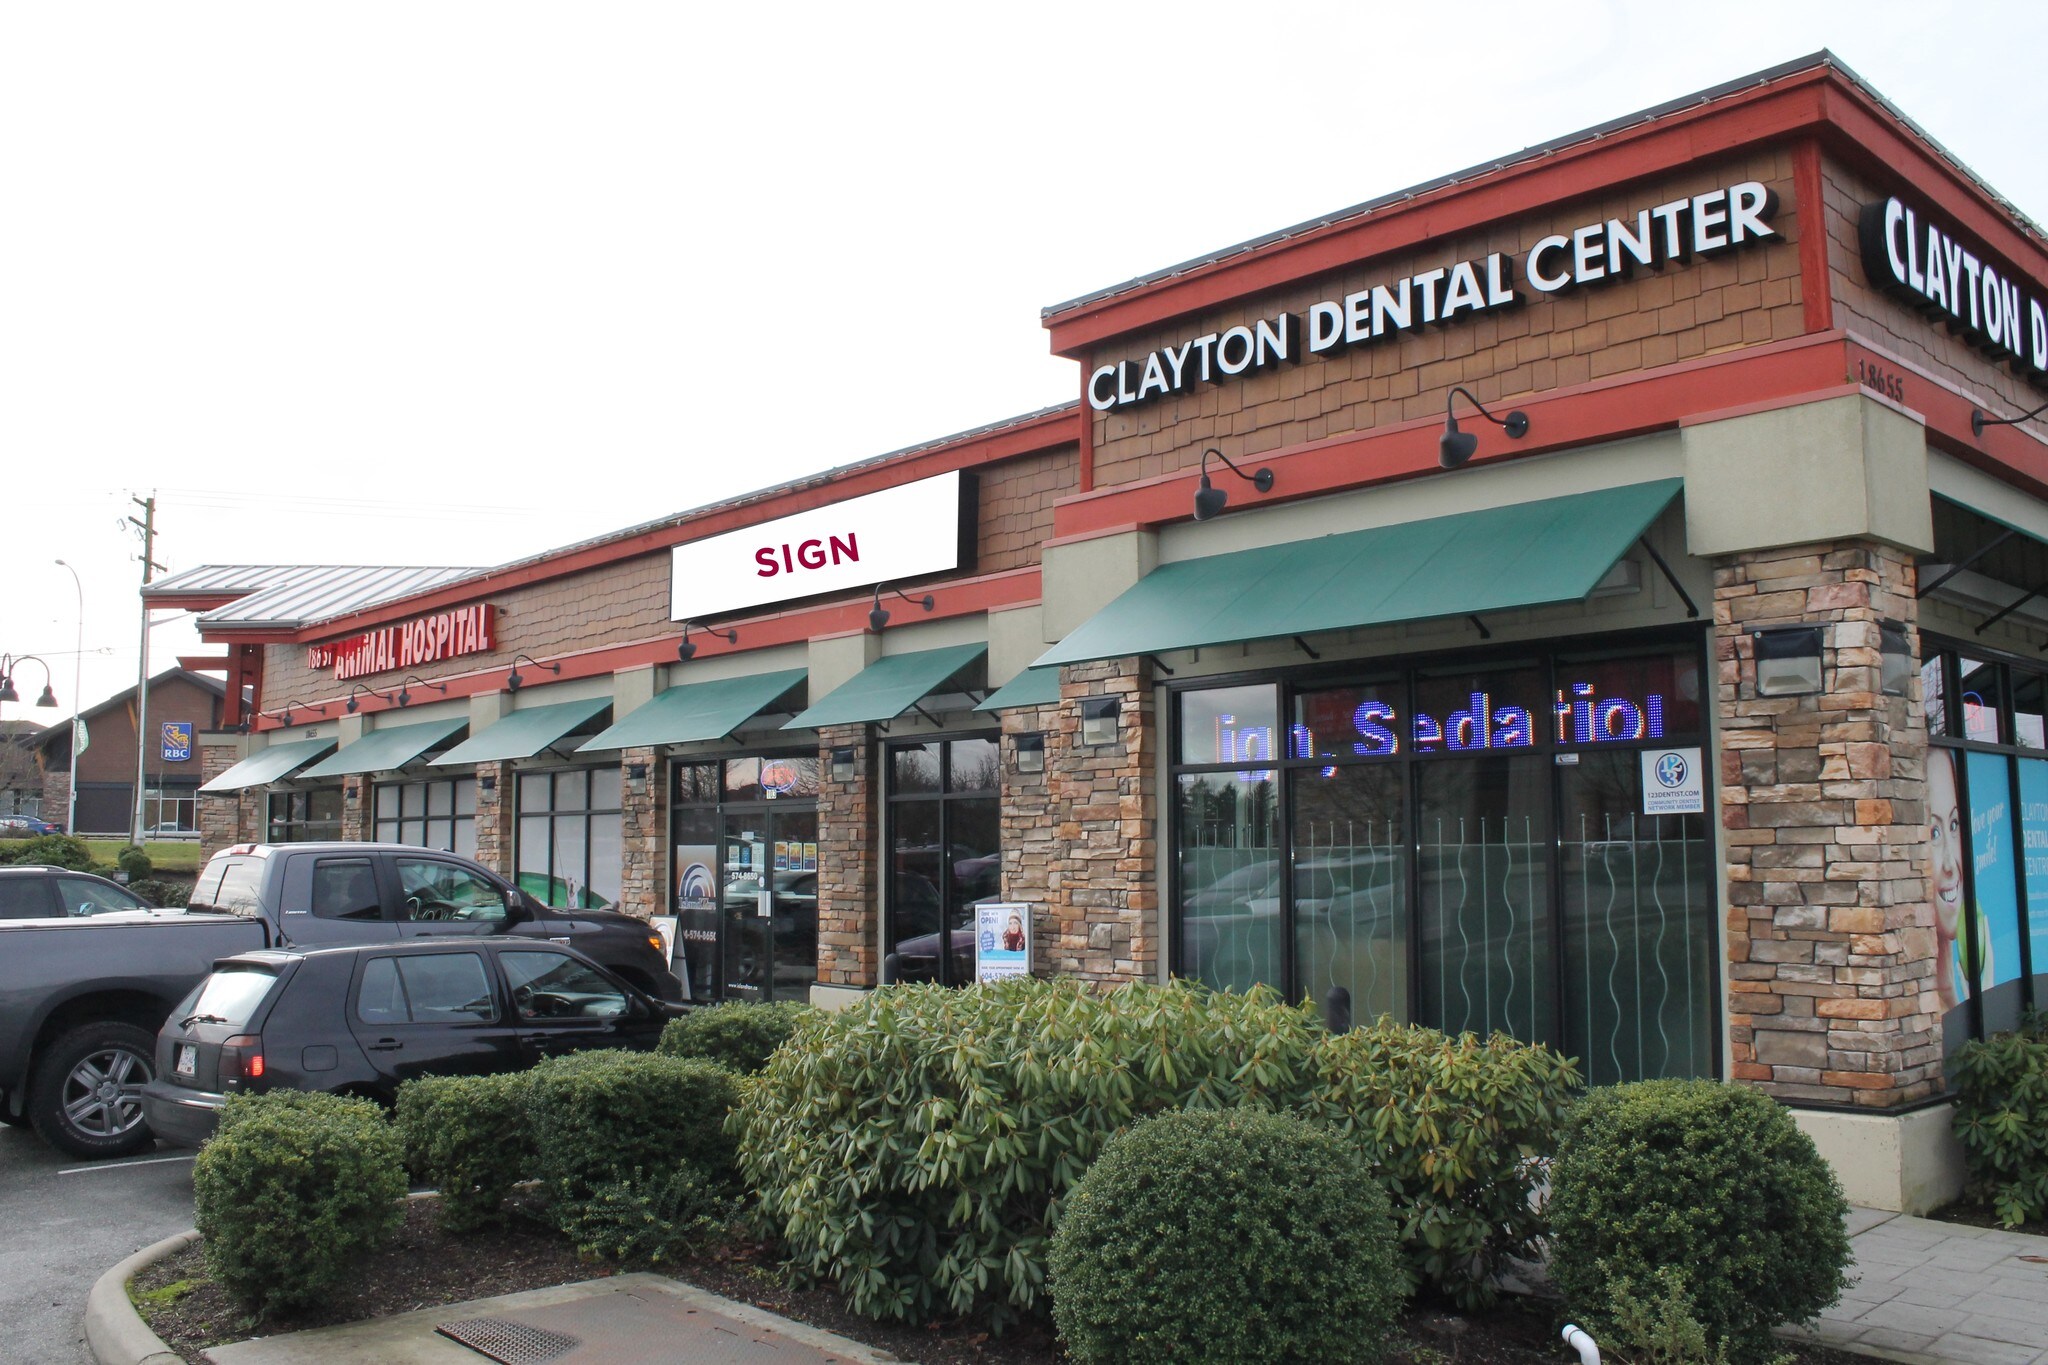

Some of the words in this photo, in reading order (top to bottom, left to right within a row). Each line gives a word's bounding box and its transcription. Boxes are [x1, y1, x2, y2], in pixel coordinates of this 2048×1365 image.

[1088, 313, 1288, 412] CLAYTON
[1308, 253, 1513, 355] DENTAL
[1526, 181, 1776, 292] CENTER
[1885, 196, 2022, 358] CLAYTON
[1859, 359, 1904, 402] 18655
[755, 532, 860, 577] SIGN
[334, 627, 395, 680] ANIMAL
[400, 603, 488, 667] HOSPITAL
[164, 749, 188, 758] RBC
[1215, 713, 1337, 782] ign,
[1647, 790, 1700, 798] 123DENTIST.COM
[1987, 802, 2005, 836] your
[731, 872, 758, 880] 574-8650
